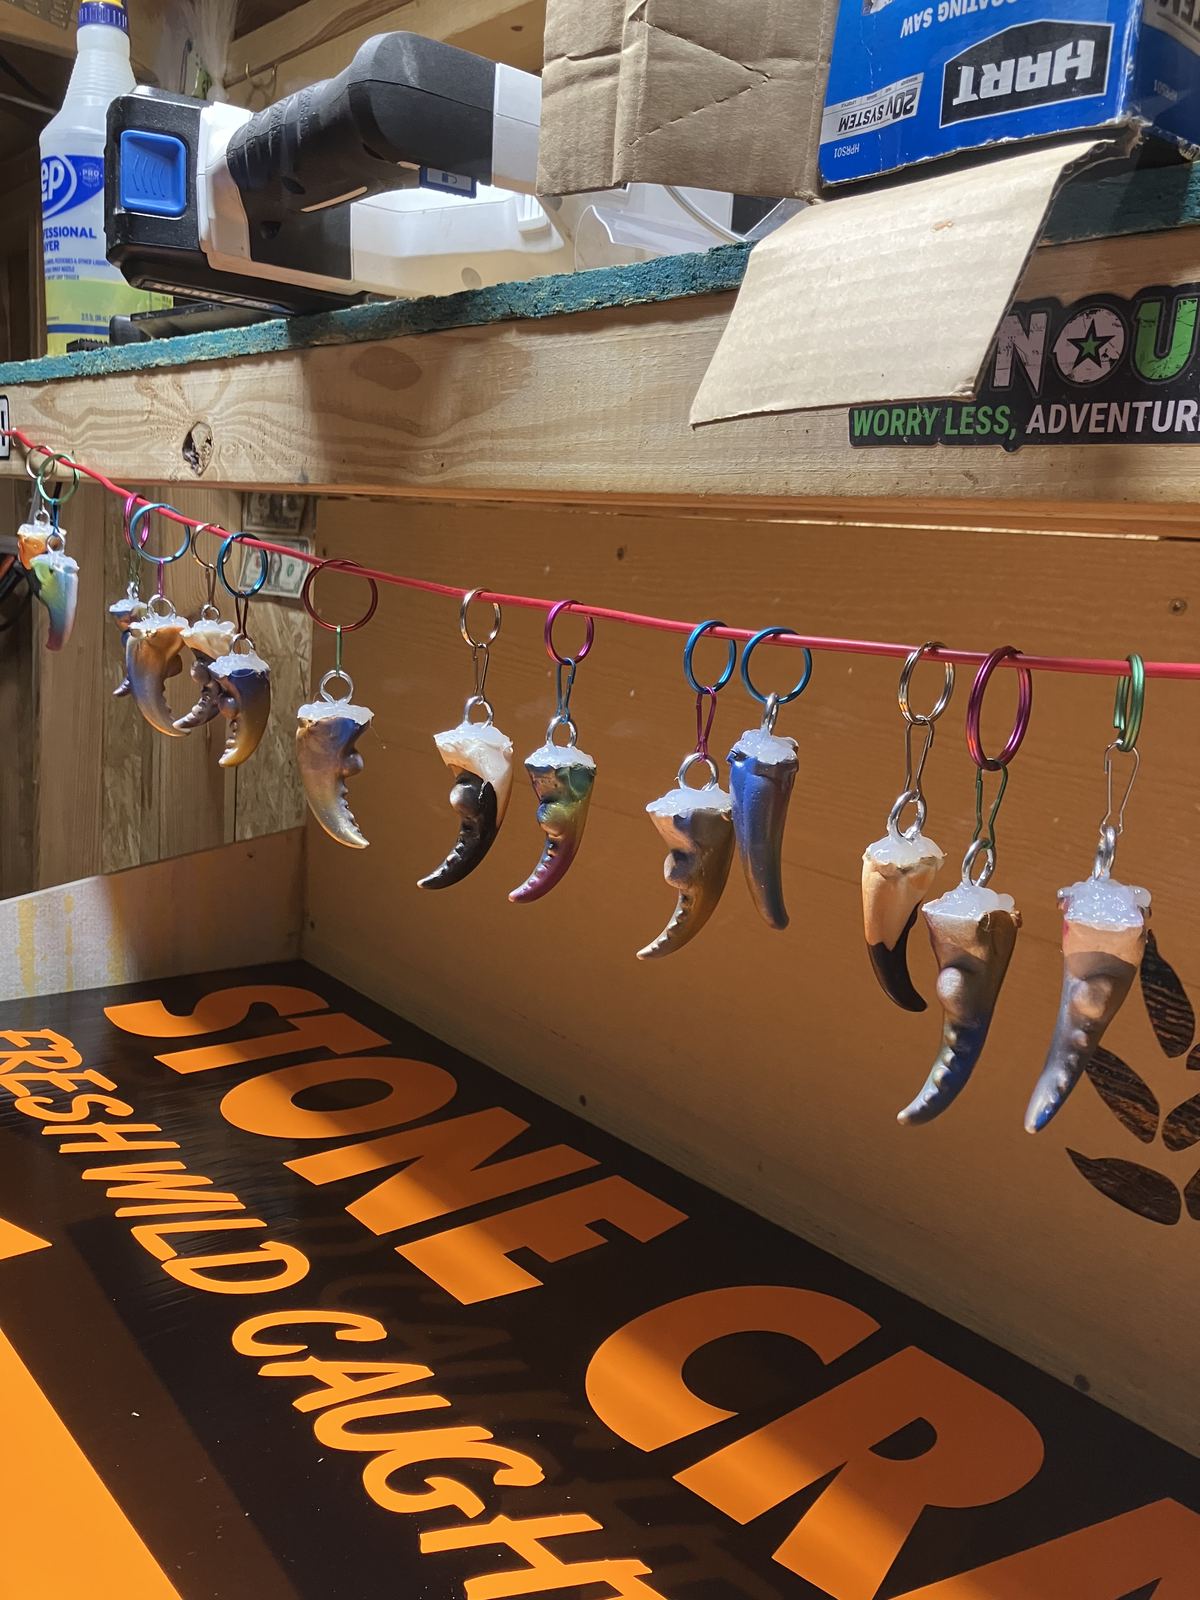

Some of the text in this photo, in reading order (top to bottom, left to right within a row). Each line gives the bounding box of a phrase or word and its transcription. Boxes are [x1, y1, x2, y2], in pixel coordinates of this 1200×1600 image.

[900, 7, 934, 38] SAW
[952, 40, 1096, 106] HART
[837, 103, 885, 133] SYSTEM
[833, 142, 860, 159] HPRS01
[82, 169, 98, 177] PRO
[853, 399, 1200, 440] WORRY LESS, ADVENTUR
[104, 985, 688, 1305] STONE
[0, 1028, 668, 1600] FRESH WILD CAUGH
